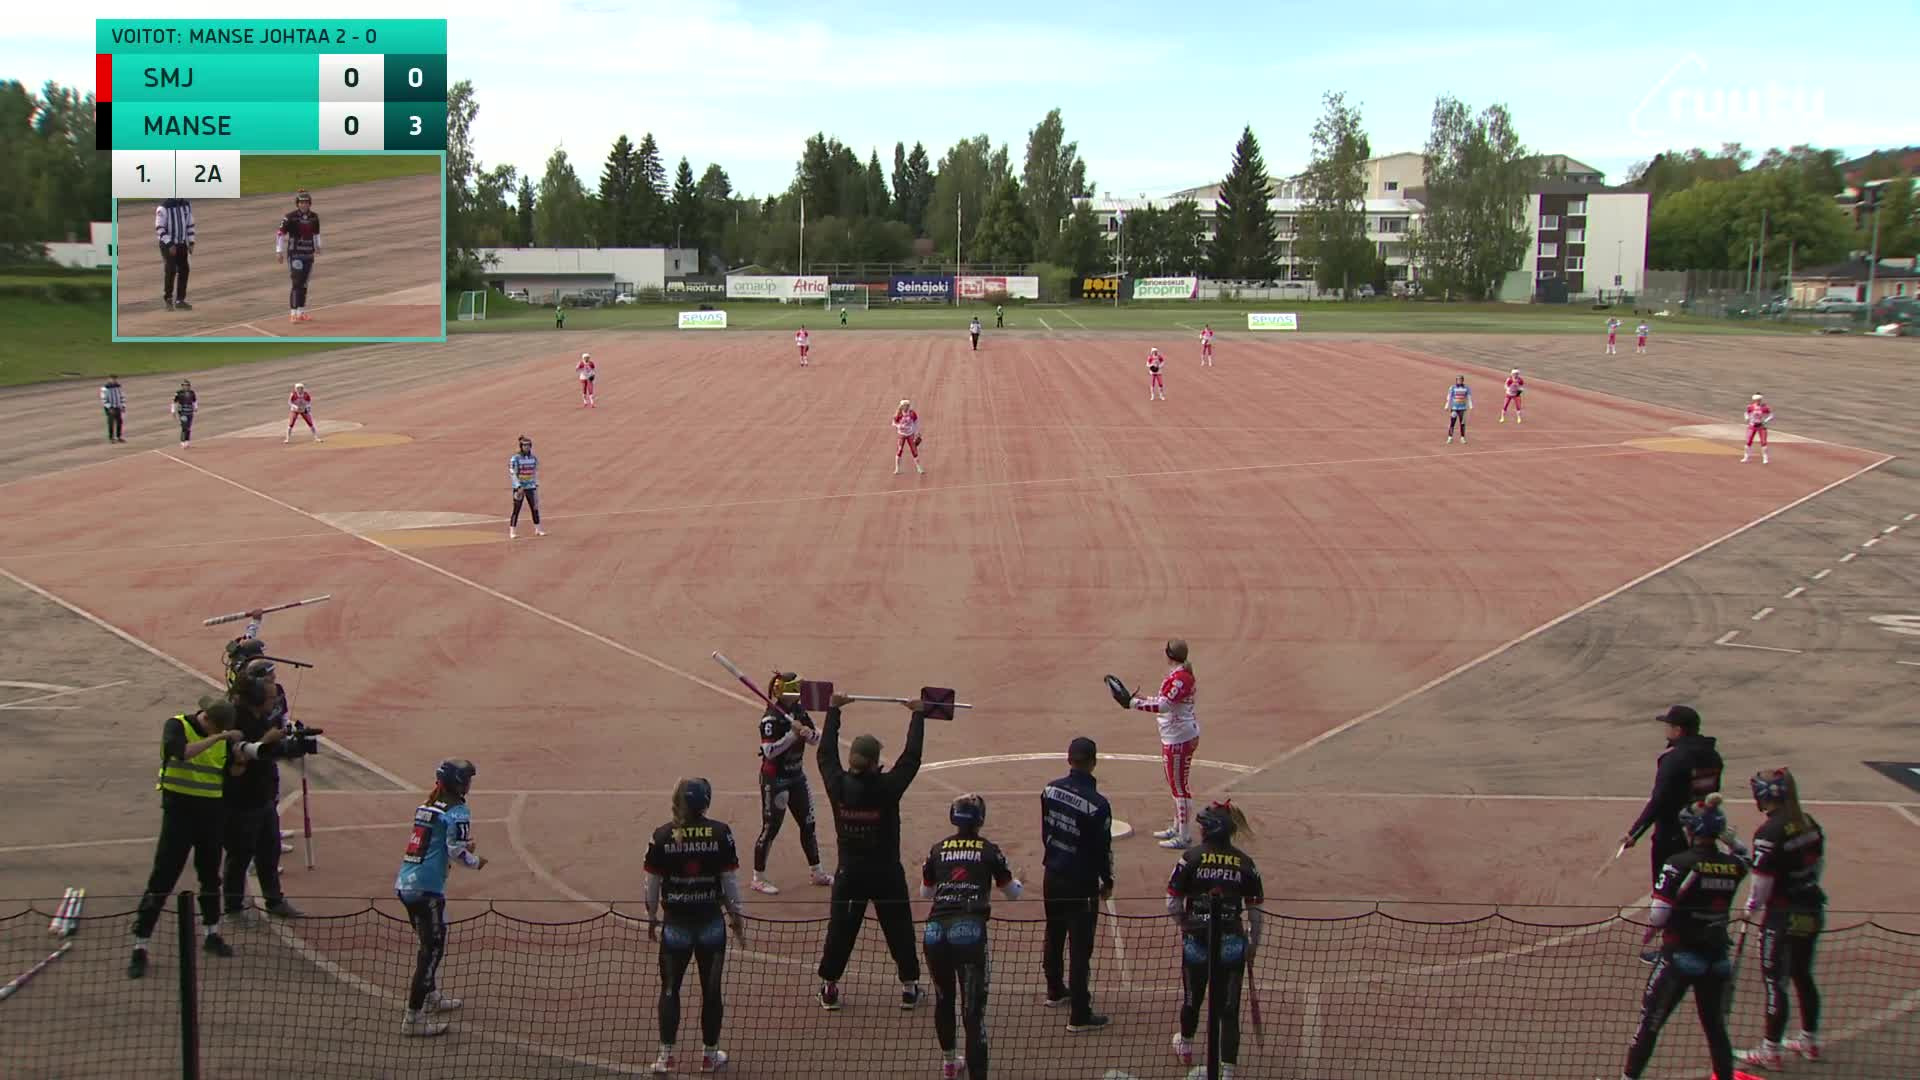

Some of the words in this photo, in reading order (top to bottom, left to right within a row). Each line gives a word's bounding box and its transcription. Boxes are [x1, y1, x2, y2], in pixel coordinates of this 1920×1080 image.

[793, 279, 825, 292] Atria
[896, 281, 949, 295] Seinäjoki
[1139, 284, 1191, 297] proprint
[942, 839, 984, 849] JATKE
[939, 850, 982, 862] TANHUA
[1200, 853, 1241, 867] JATKE
[1196, 868, 1242, 882] KORPELA
